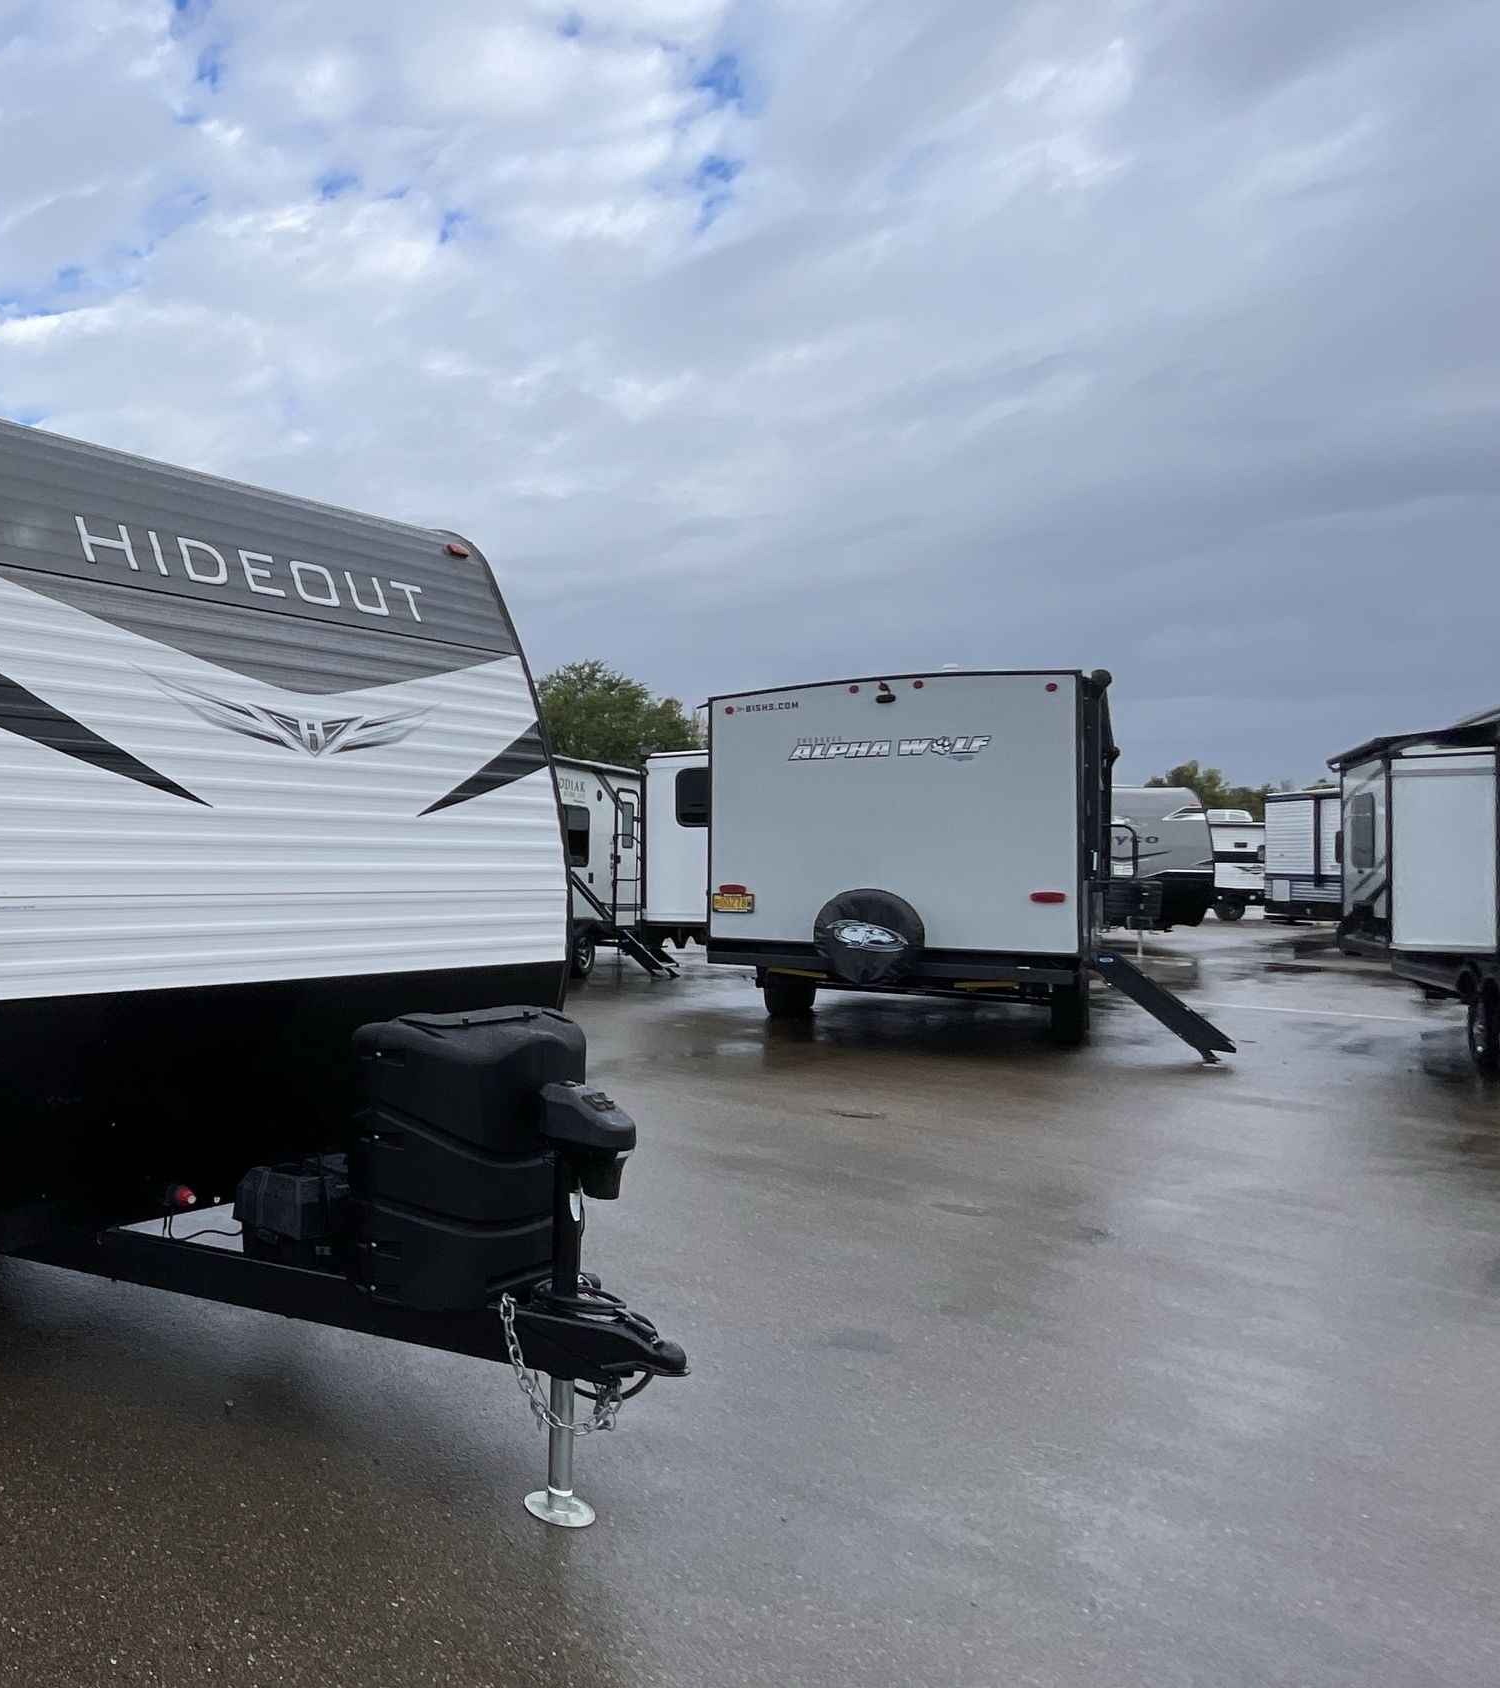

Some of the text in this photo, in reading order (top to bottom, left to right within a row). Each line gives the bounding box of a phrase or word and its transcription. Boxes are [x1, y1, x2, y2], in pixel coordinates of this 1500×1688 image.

[74, 515, 423, 623] HIDEOUT
[745, 701, 799, 713] BISHS.COM
[787, 740, 891, 761] ALPHA
[559, 777, 586, 793] ODIAK
